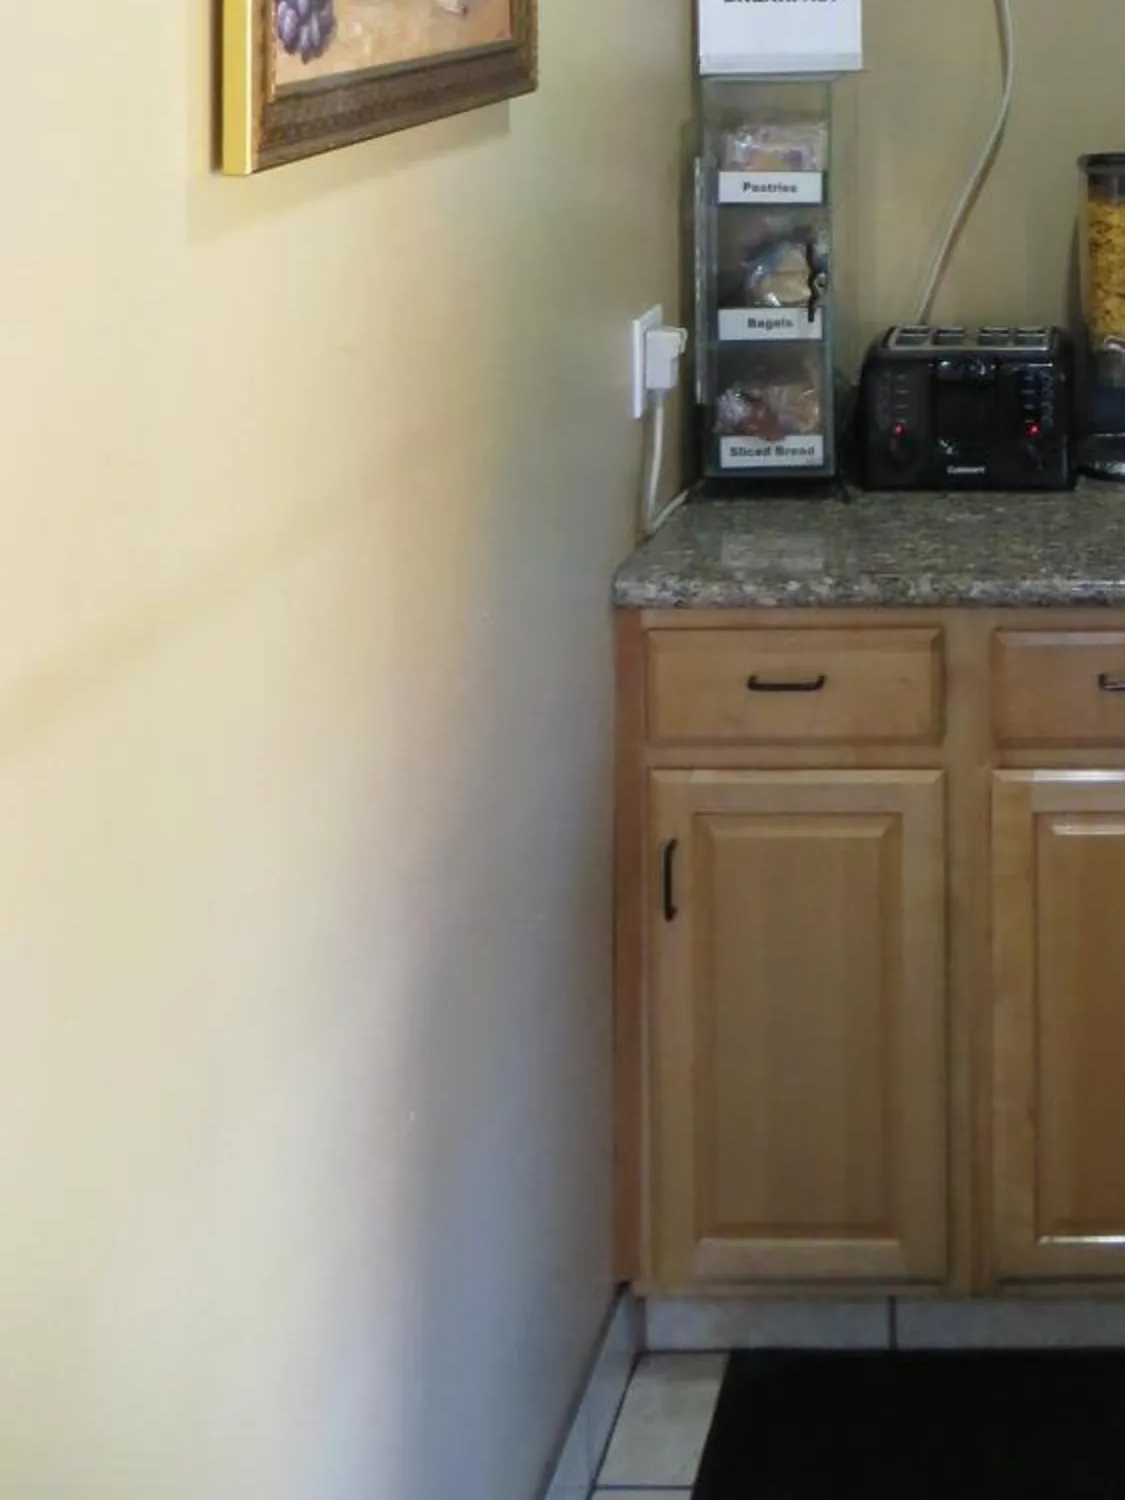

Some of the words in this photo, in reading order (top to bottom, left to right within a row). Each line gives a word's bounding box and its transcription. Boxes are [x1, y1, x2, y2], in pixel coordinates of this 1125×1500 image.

[742, 181, 798, 193] Pastries
[747, 317, 794, 331] Bagels
[729, 446, 771, 457] Sliced
[775, 445, 815, 457] Bread
